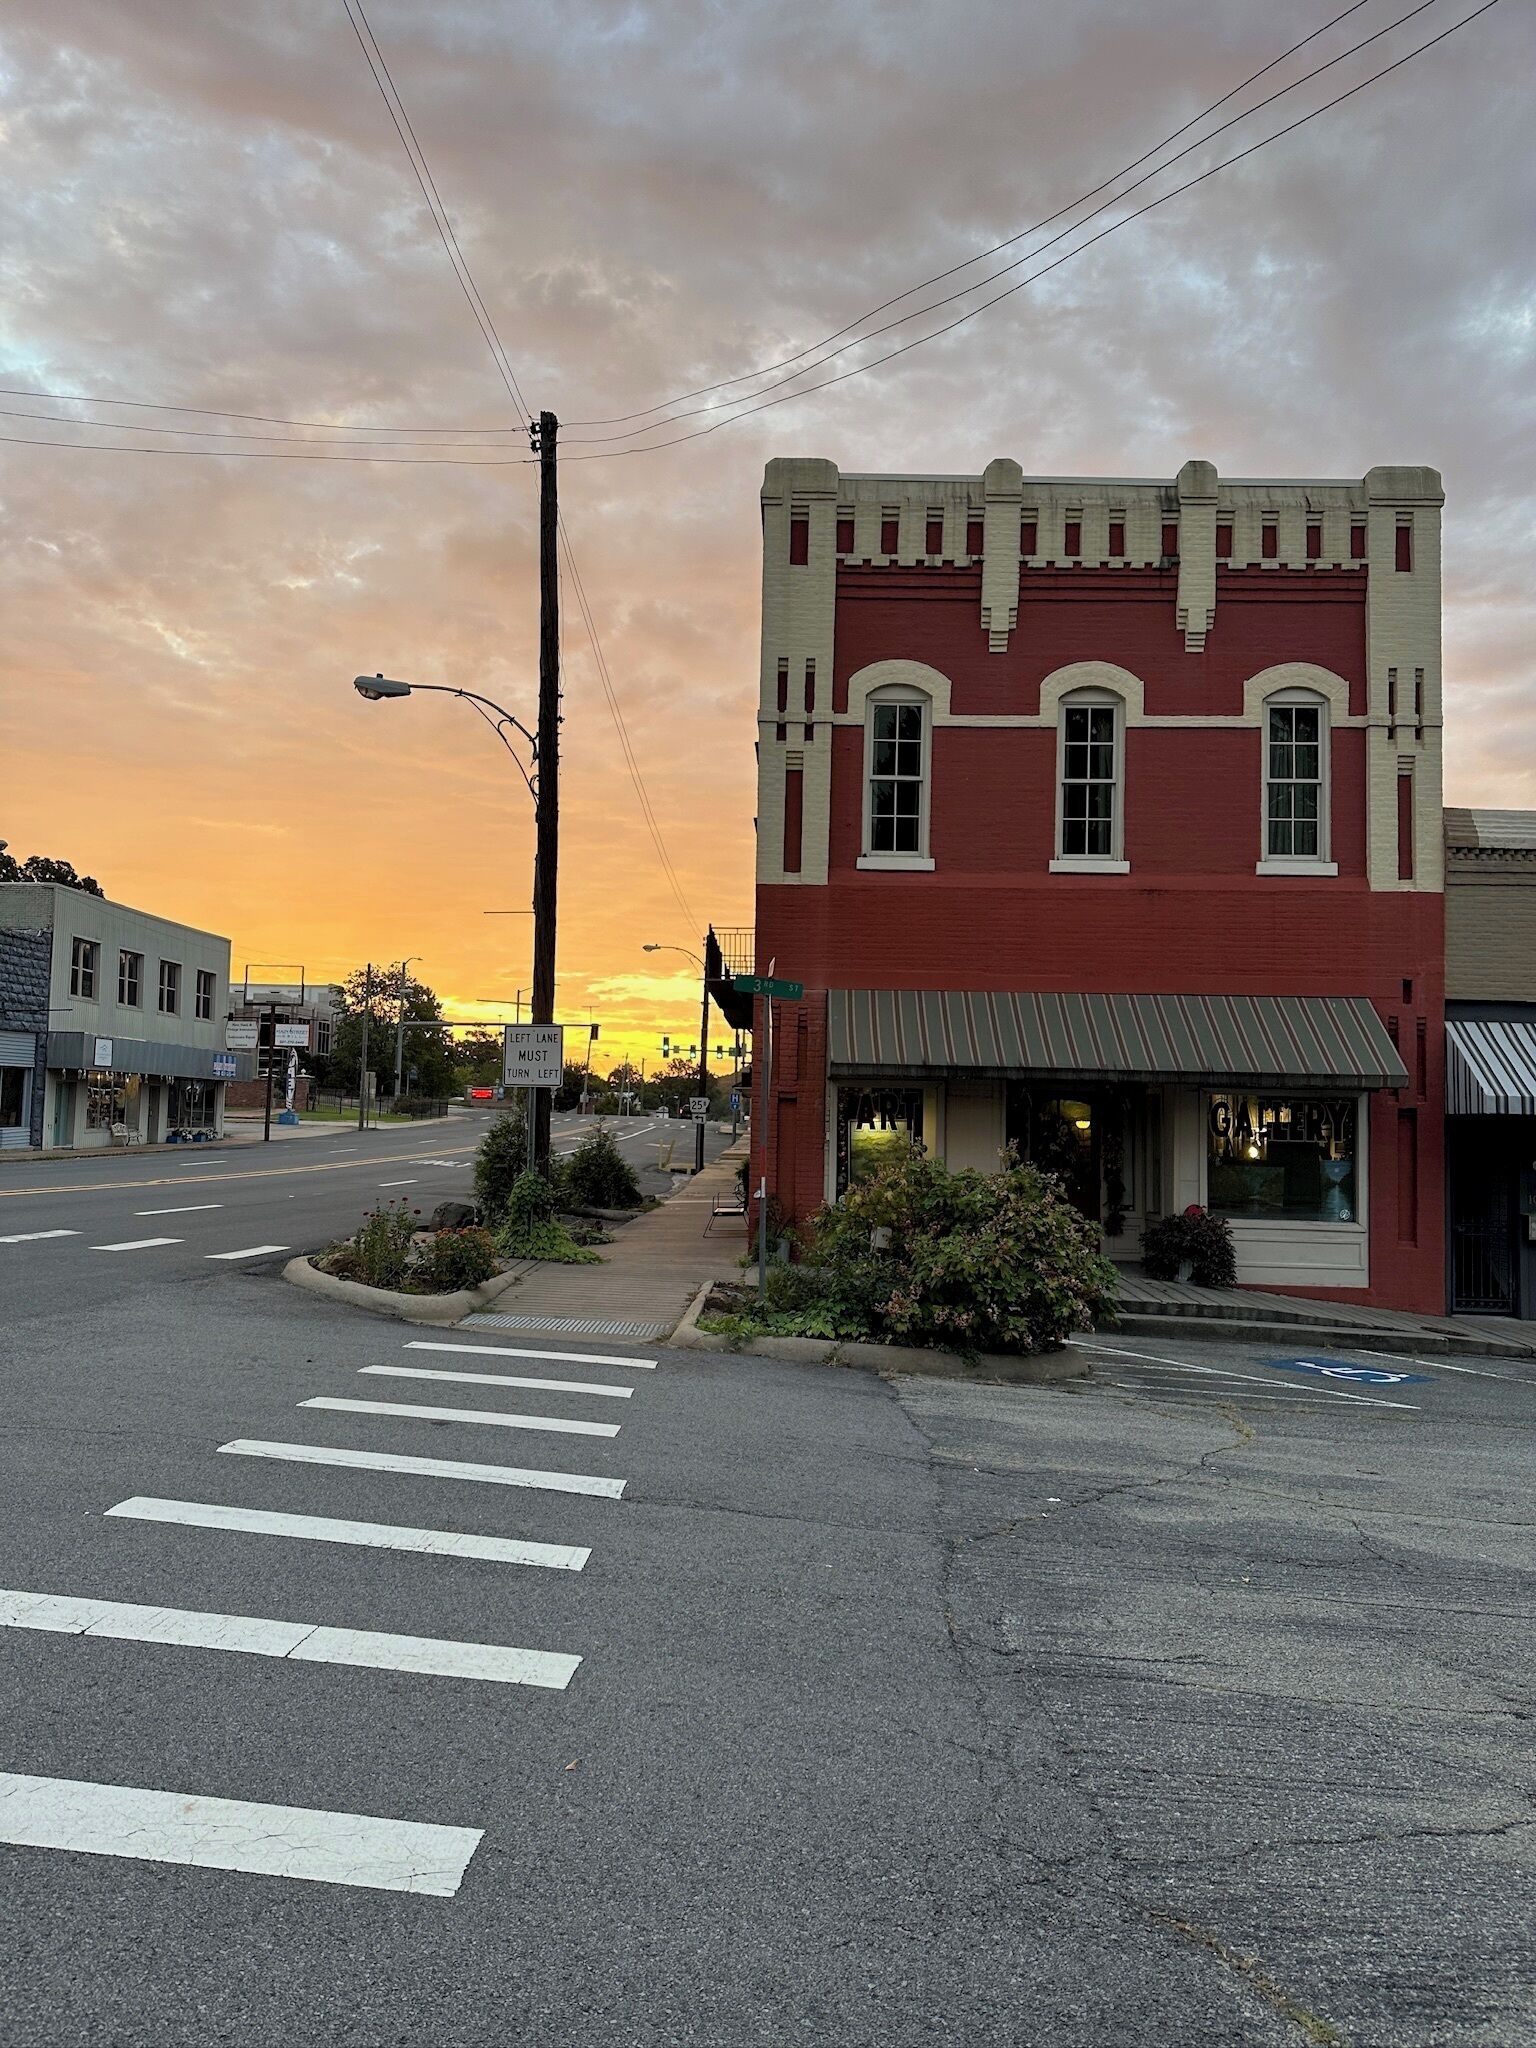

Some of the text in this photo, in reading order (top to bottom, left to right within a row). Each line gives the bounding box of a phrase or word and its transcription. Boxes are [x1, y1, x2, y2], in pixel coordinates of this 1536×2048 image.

[753, 979, 799, 993] 3RD ST
[510, 1033, 559, 1043] LEFT LANE
[518, 1050, 548, 1061] MUST
[507, 1068, 559, 1079] TURN LEFT
[731, 1094, 739, 1103] H
[856, 1092, 921, 1132] ART
[1209, 1098, 1351, 1143] GALLERY
